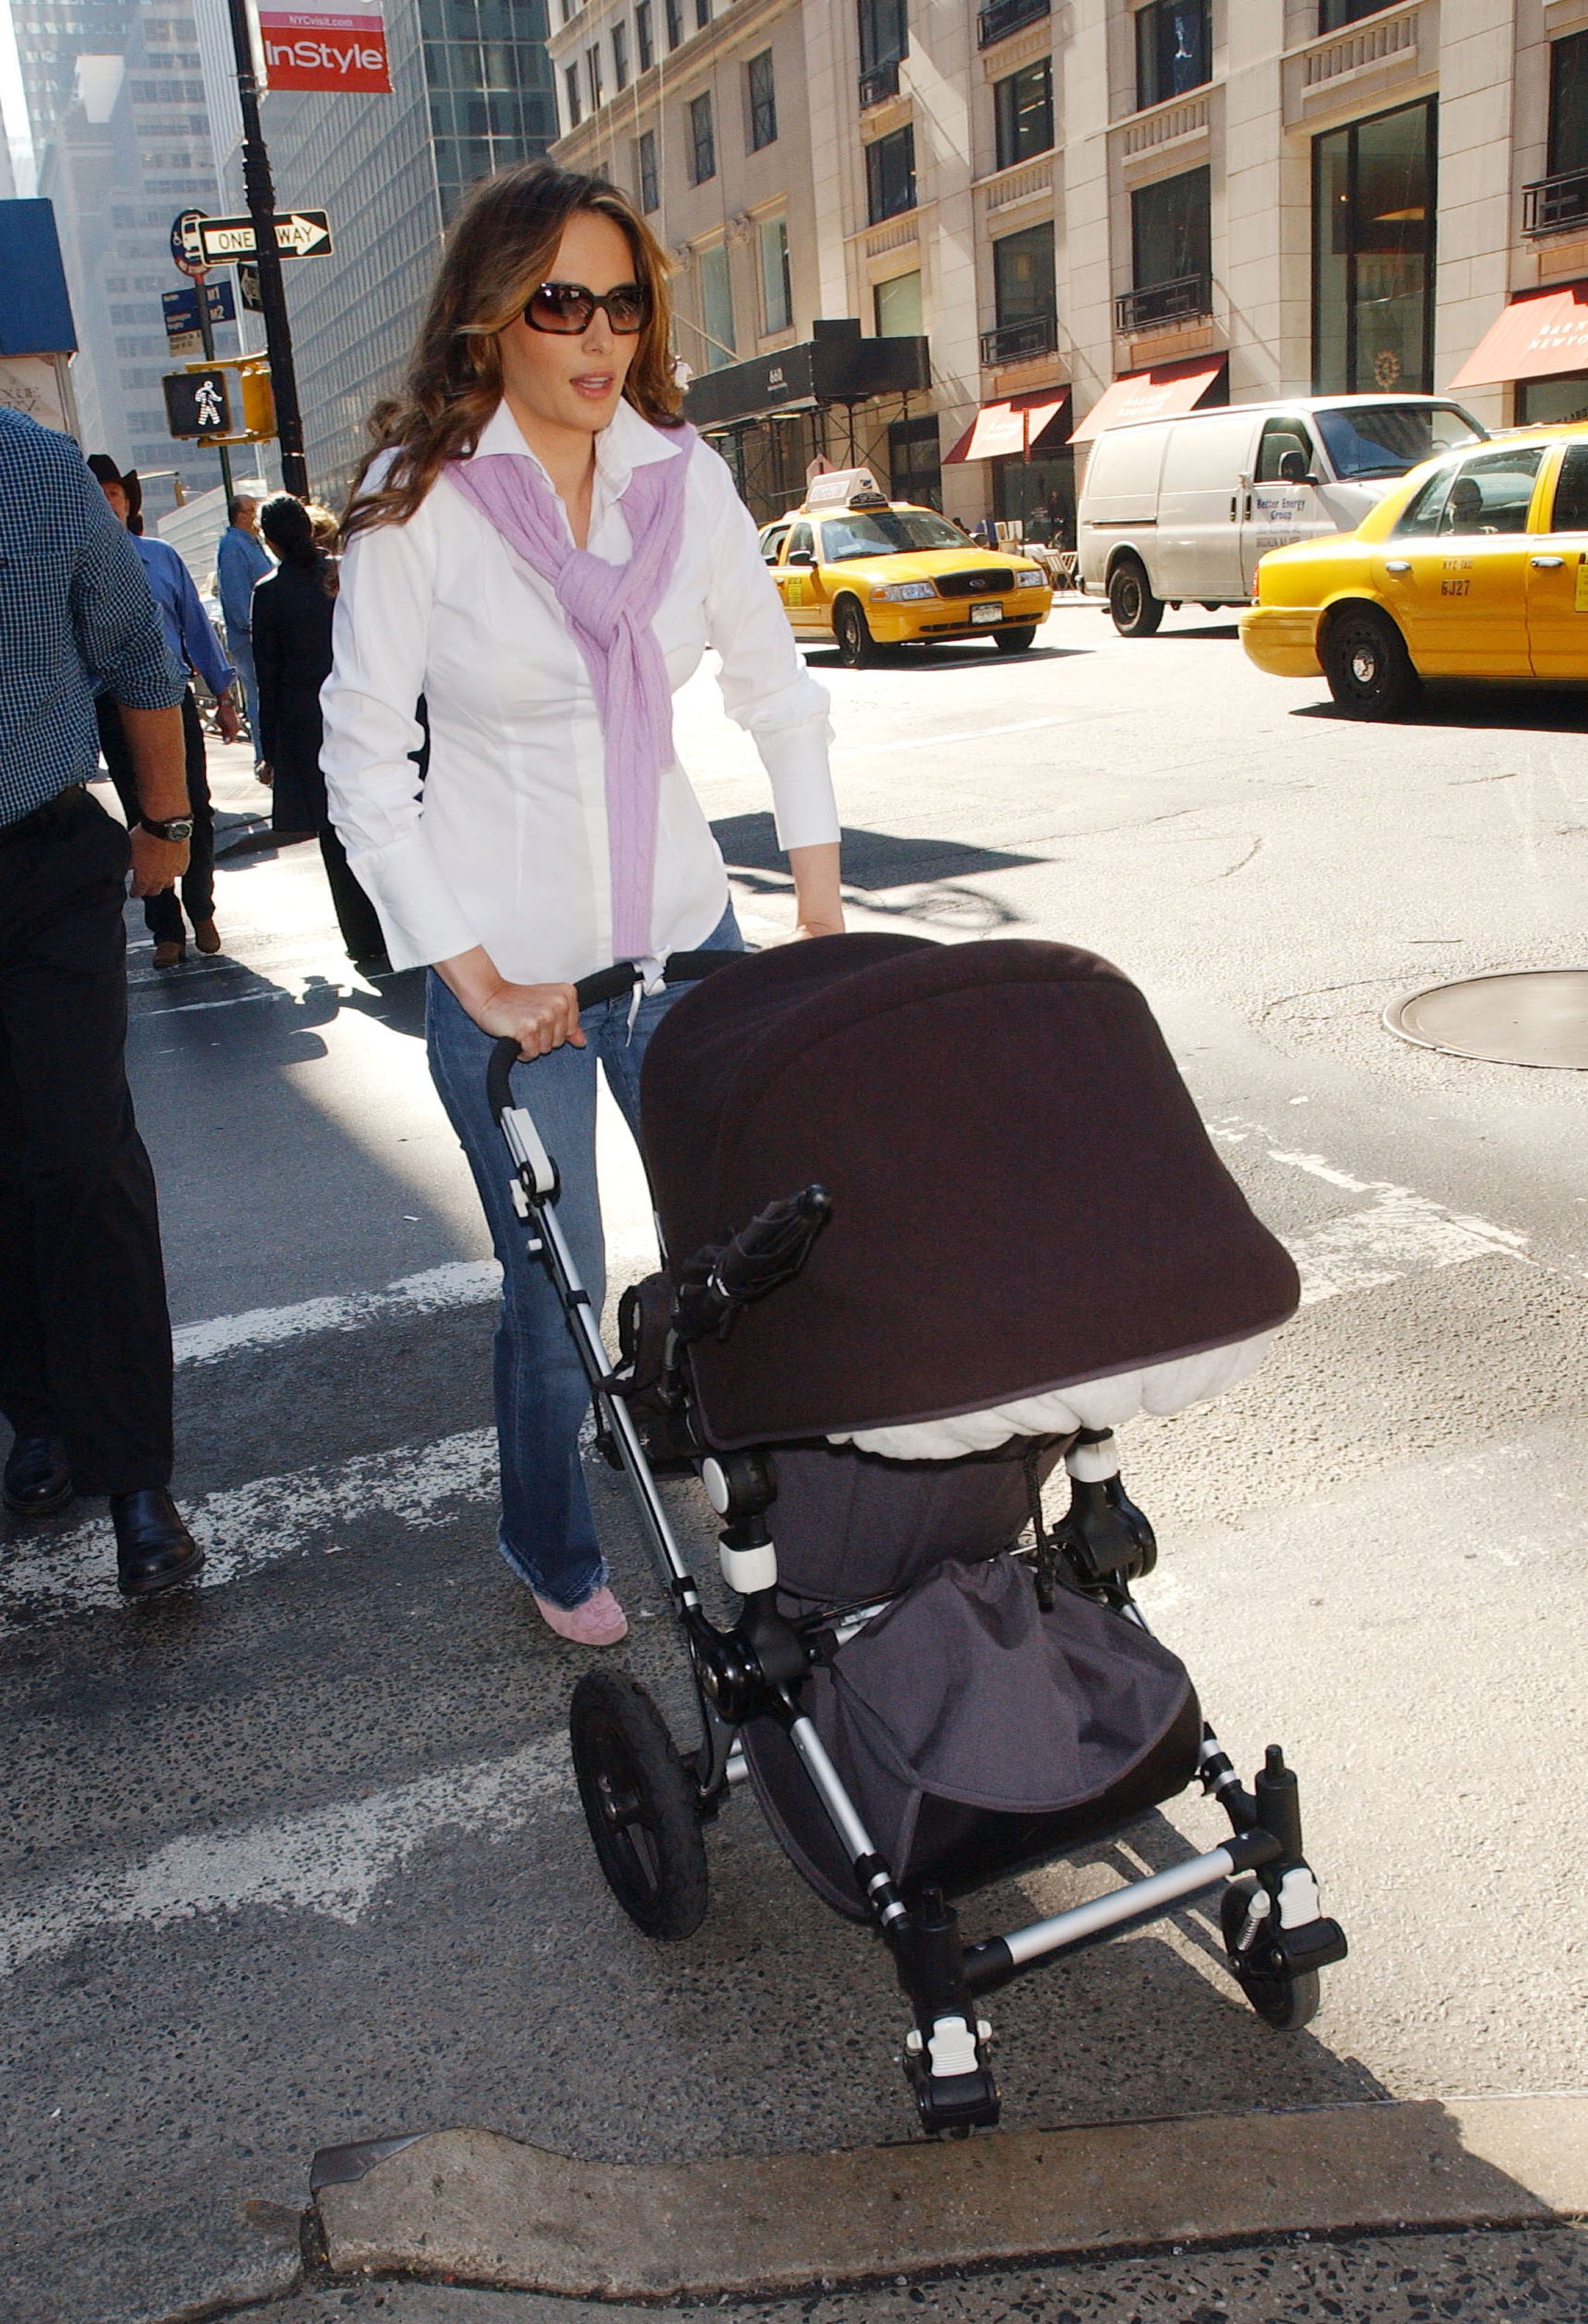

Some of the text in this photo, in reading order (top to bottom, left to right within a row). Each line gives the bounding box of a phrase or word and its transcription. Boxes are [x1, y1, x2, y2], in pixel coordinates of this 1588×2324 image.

[289, 15, 353, 26] NYCvisit.com
[264, 40, 383, 74] InStyle
[218, 226, 313, 250] ONE WAY
